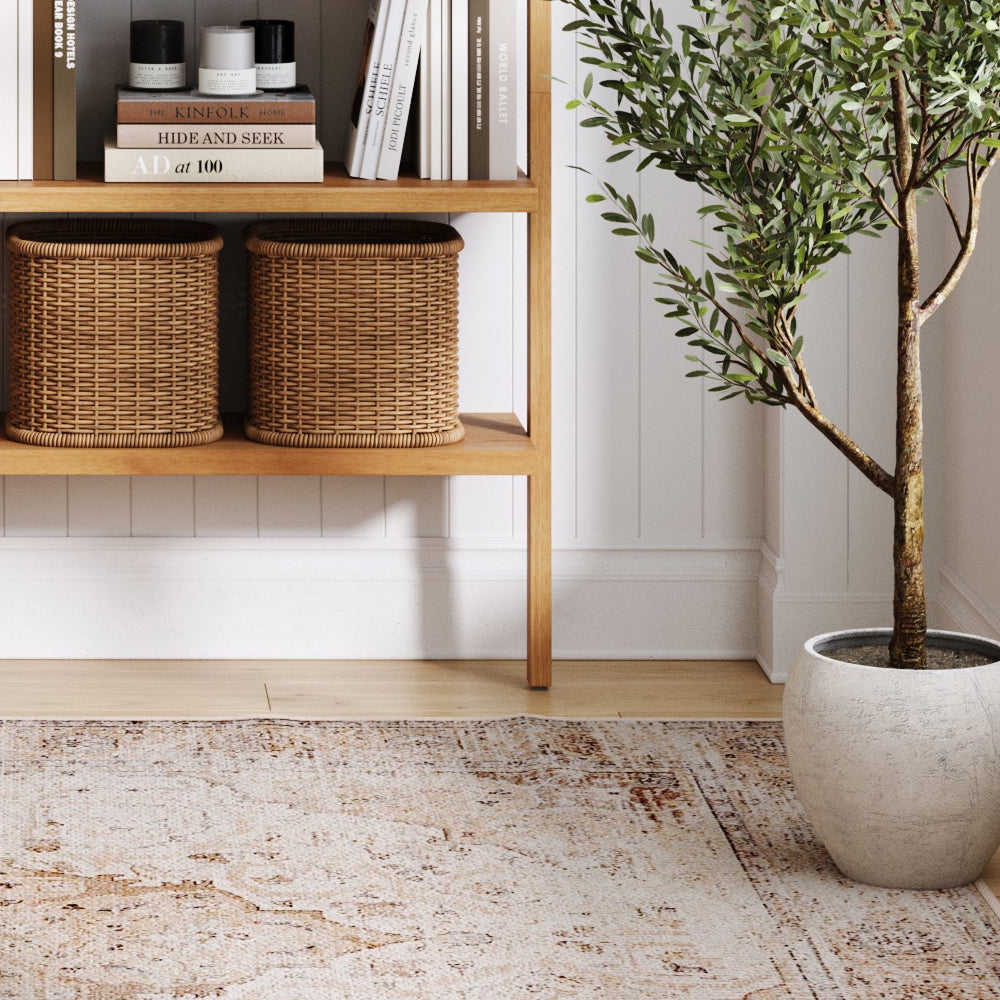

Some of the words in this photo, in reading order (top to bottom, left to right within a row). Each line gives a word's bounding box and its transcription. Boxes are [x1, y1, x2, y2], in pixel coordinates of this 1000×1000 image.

[54, 22, 63, 49] BOOK
[409, 12, 418, 38] glance
[66, 32, 76, 70] HOTELS
[404, 39, 413, 67] second
[499, 42, 508, 82] WORLD
[376, 63, 393, 117] SCHIELE
[175, 106, 249, 119] KINFOLK
[392, 83, 407, 127] PICOULT
[499, 86, 508, 125] BALLET
[158, 132, 199, 145] HIDE
[203, 132, 237, 145] AND
[241, 132, 285, 145] SEEK
[389, 127, 400, 151] JODI
[132, 155, 170, 175] AD
[175, 160, 191, 174] at
[197, 160, 223, 173] 100
